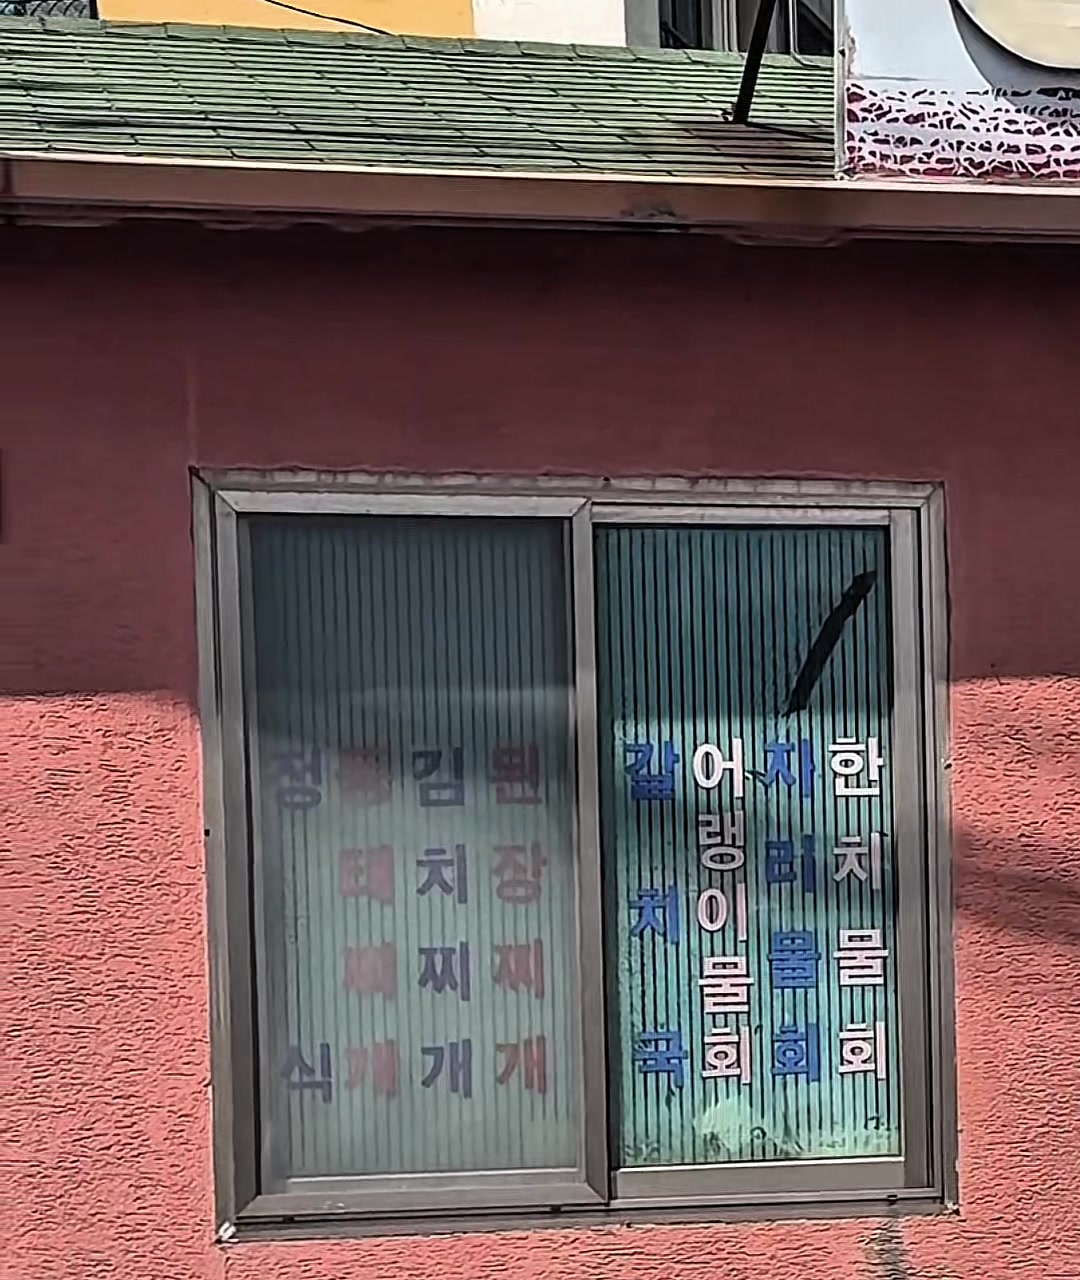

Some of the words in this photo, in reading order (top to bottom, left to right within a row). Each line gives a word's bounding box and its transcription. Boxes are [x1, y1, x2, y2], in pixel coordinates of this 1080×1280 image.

[412, 746, 472, 1099] 김치찌개
[491, 741, 547, 1095] 된장찌개
[626, 739, 688, 1089] 갈치국
[692, 736, 754, 1085] 어랭이물회
[764, 738, 821, 1083] 자리물회
[828, 735, 889, 1081] 한치물회
